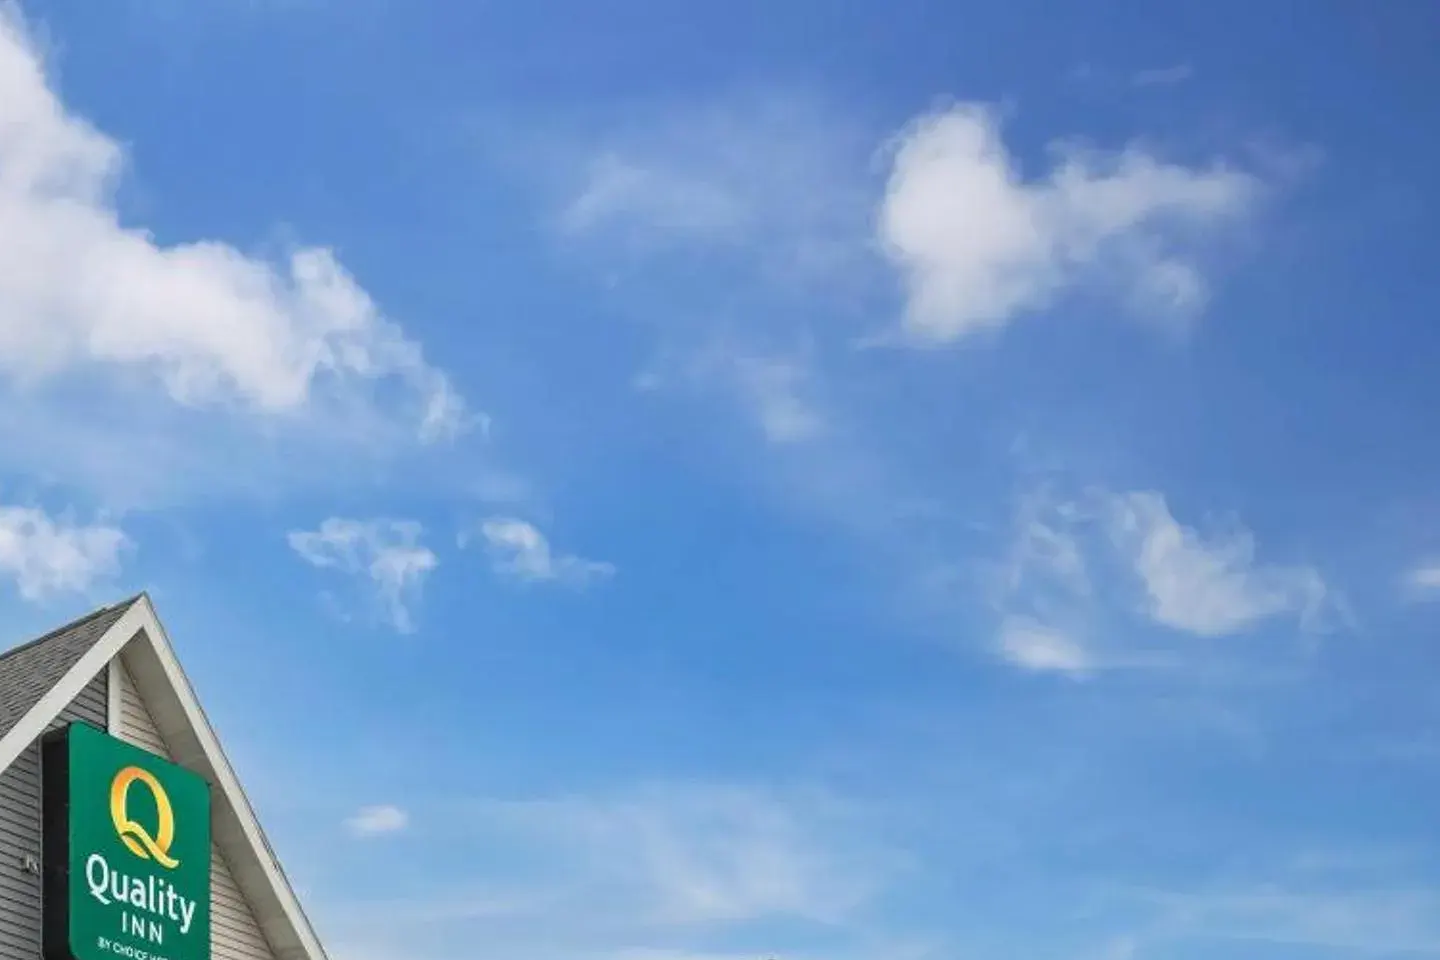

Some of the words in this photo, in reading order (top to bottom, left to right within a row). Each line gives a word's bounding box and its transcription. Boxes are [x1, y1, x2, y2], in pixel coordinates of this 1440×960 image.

[110, 765, 179, 869] Q
[85, 854, 196, 933] Quality
[97, 936, 111, 949] BY
[122, 911, 163, 945] INN
